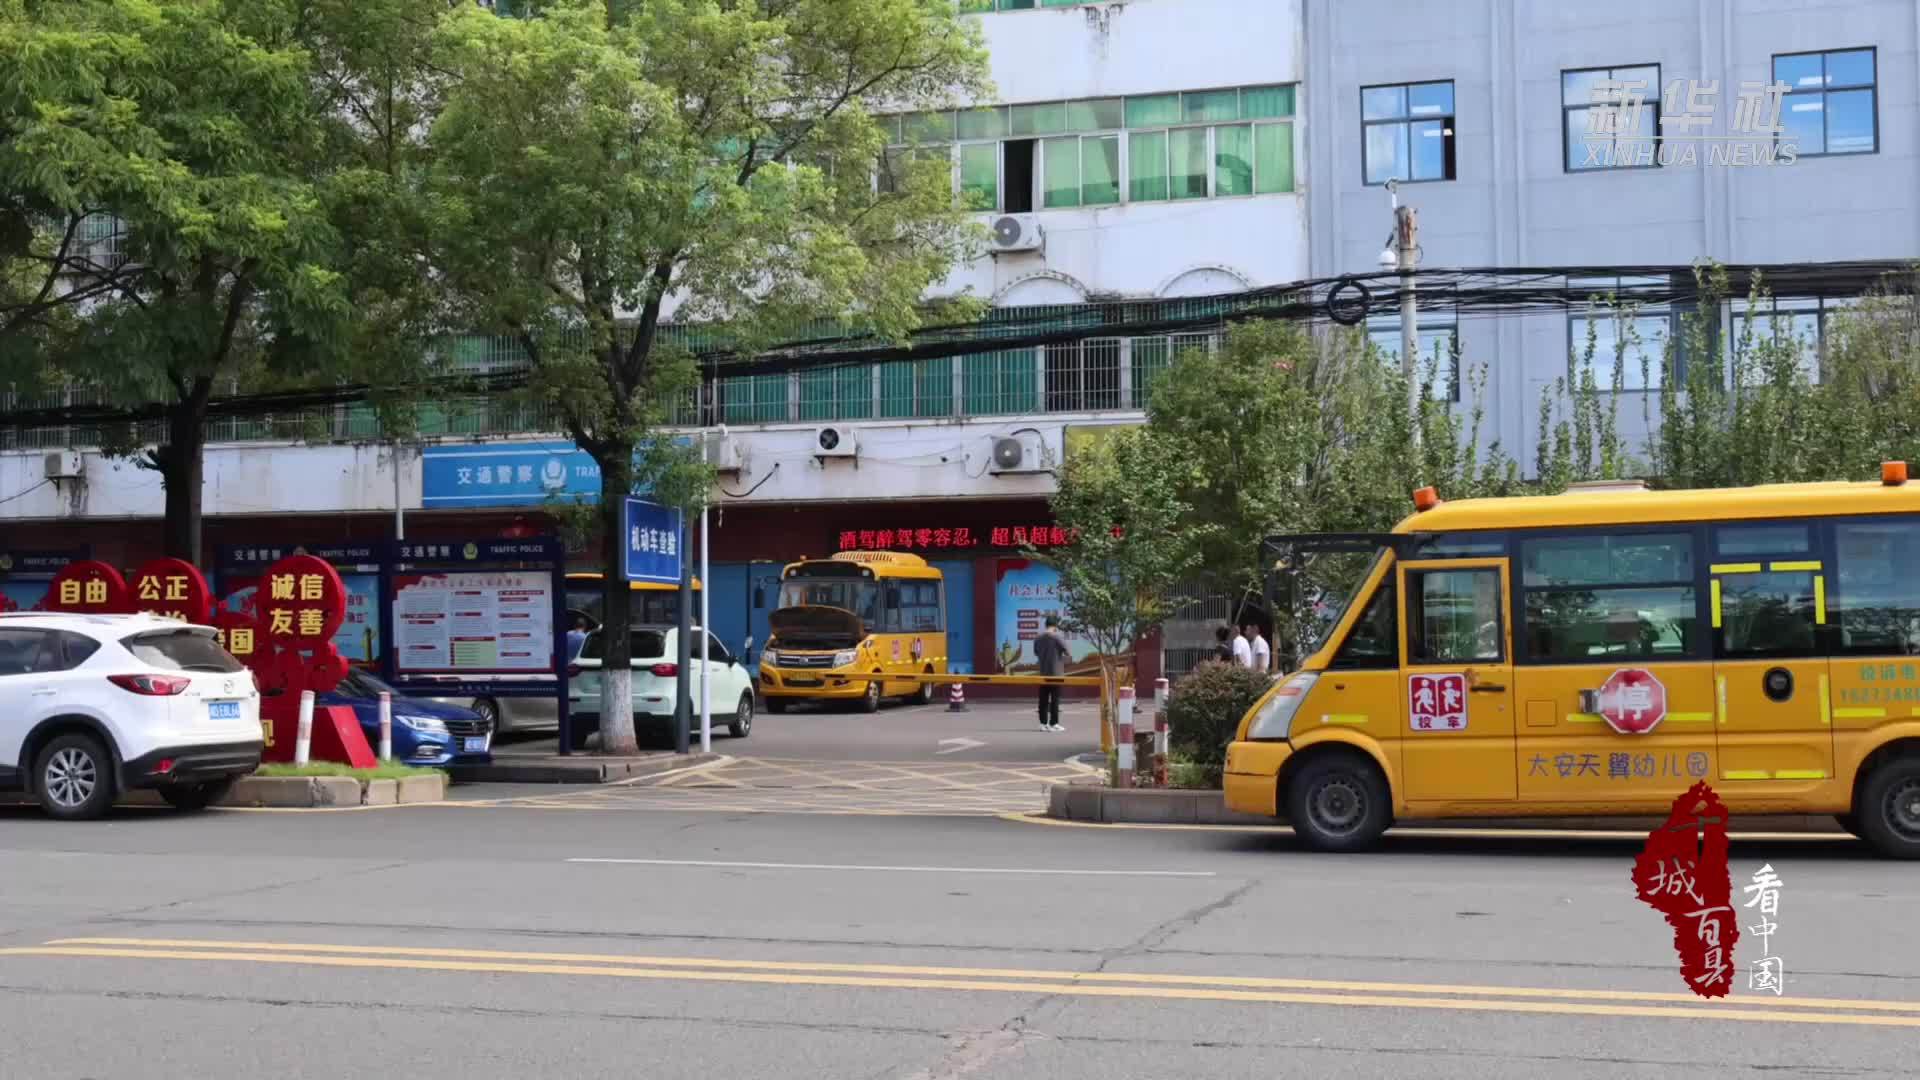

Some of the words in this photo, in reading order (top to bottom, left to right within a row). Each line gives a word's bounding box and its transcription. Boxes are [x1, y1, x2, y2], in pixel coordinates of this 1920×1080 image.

[457, 464, 533, 485] 交通警察
[490, 545, 517, 553] TRAFFIC
[519, 544, 544, 553] POLICE
[631, 525, 677, 557] 机动车查验
[60, 578, 107, 604] 自由
[138, 575, 188, 601] 公正
[270, 573, 324, 600] 诚信
[270, 608, 324, 635] 友善
[1617, 681, 1653, 720] 停
[1418, 716, 1461, 729] 校车
[1527, 751, 1709, 778] 大安天翼幼儿园
